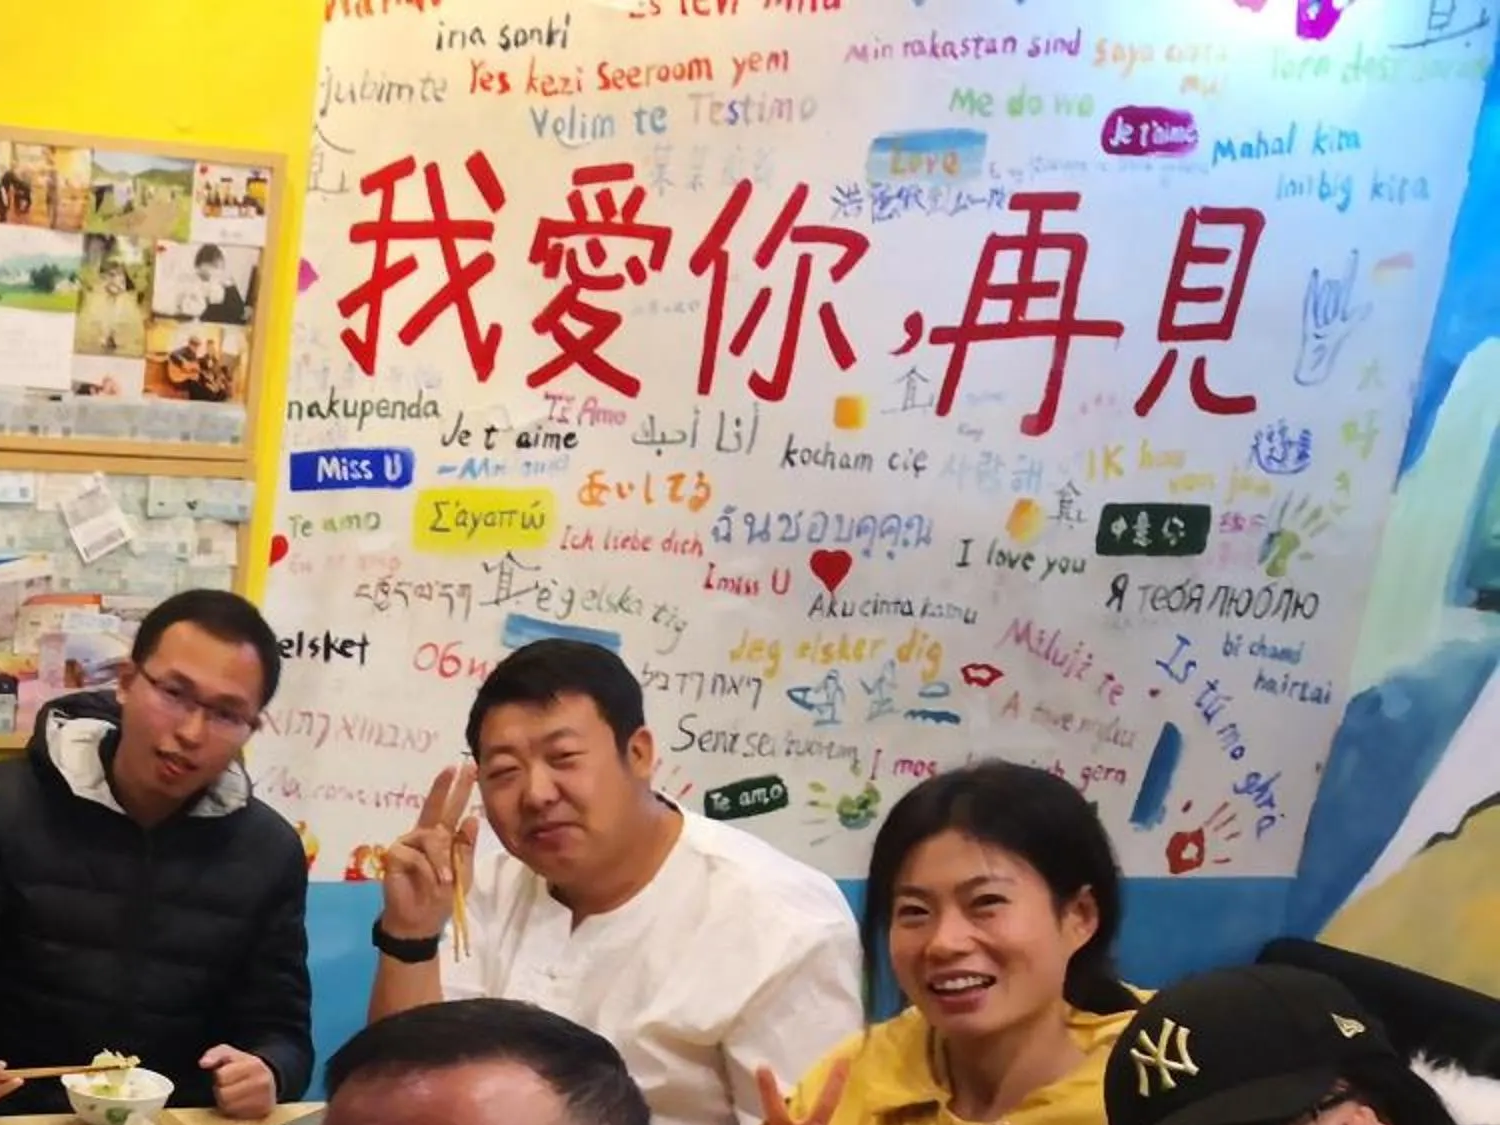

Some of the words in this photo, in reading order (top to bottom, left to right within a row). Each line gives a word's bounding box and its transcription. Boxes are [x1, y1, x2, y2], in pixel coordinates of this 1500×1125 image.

[468, 57, 512, 96] Yes
[525, 54, 584, 97] kezi
[597, 55, 715, 91] Seeroom
[731, 48, 790, 89] yem
[634, 104, 668, 136] te
[287, 386, 443, 432] nakupenda
[440, 409, 474, 448] Je
[317, 453, 373, 483] Miss
[383, 453, 403, 481] U
[780, 432, 874, 472] kocham
[559, 523, 594, 552] Ich
[603, 524, 653, 553] liebe
[661, 528, 705, 558] dich
[955, 538, 975, 568] I
[986, 537, 1036, 572] love
[1039, 554, 1088, 582] you
[771, 565, 793, 597] U
[1105, 572, 1130, 614] Я
[739, 784, 784, 807] amo
[1130, 1018, 1199, 1097] NY
